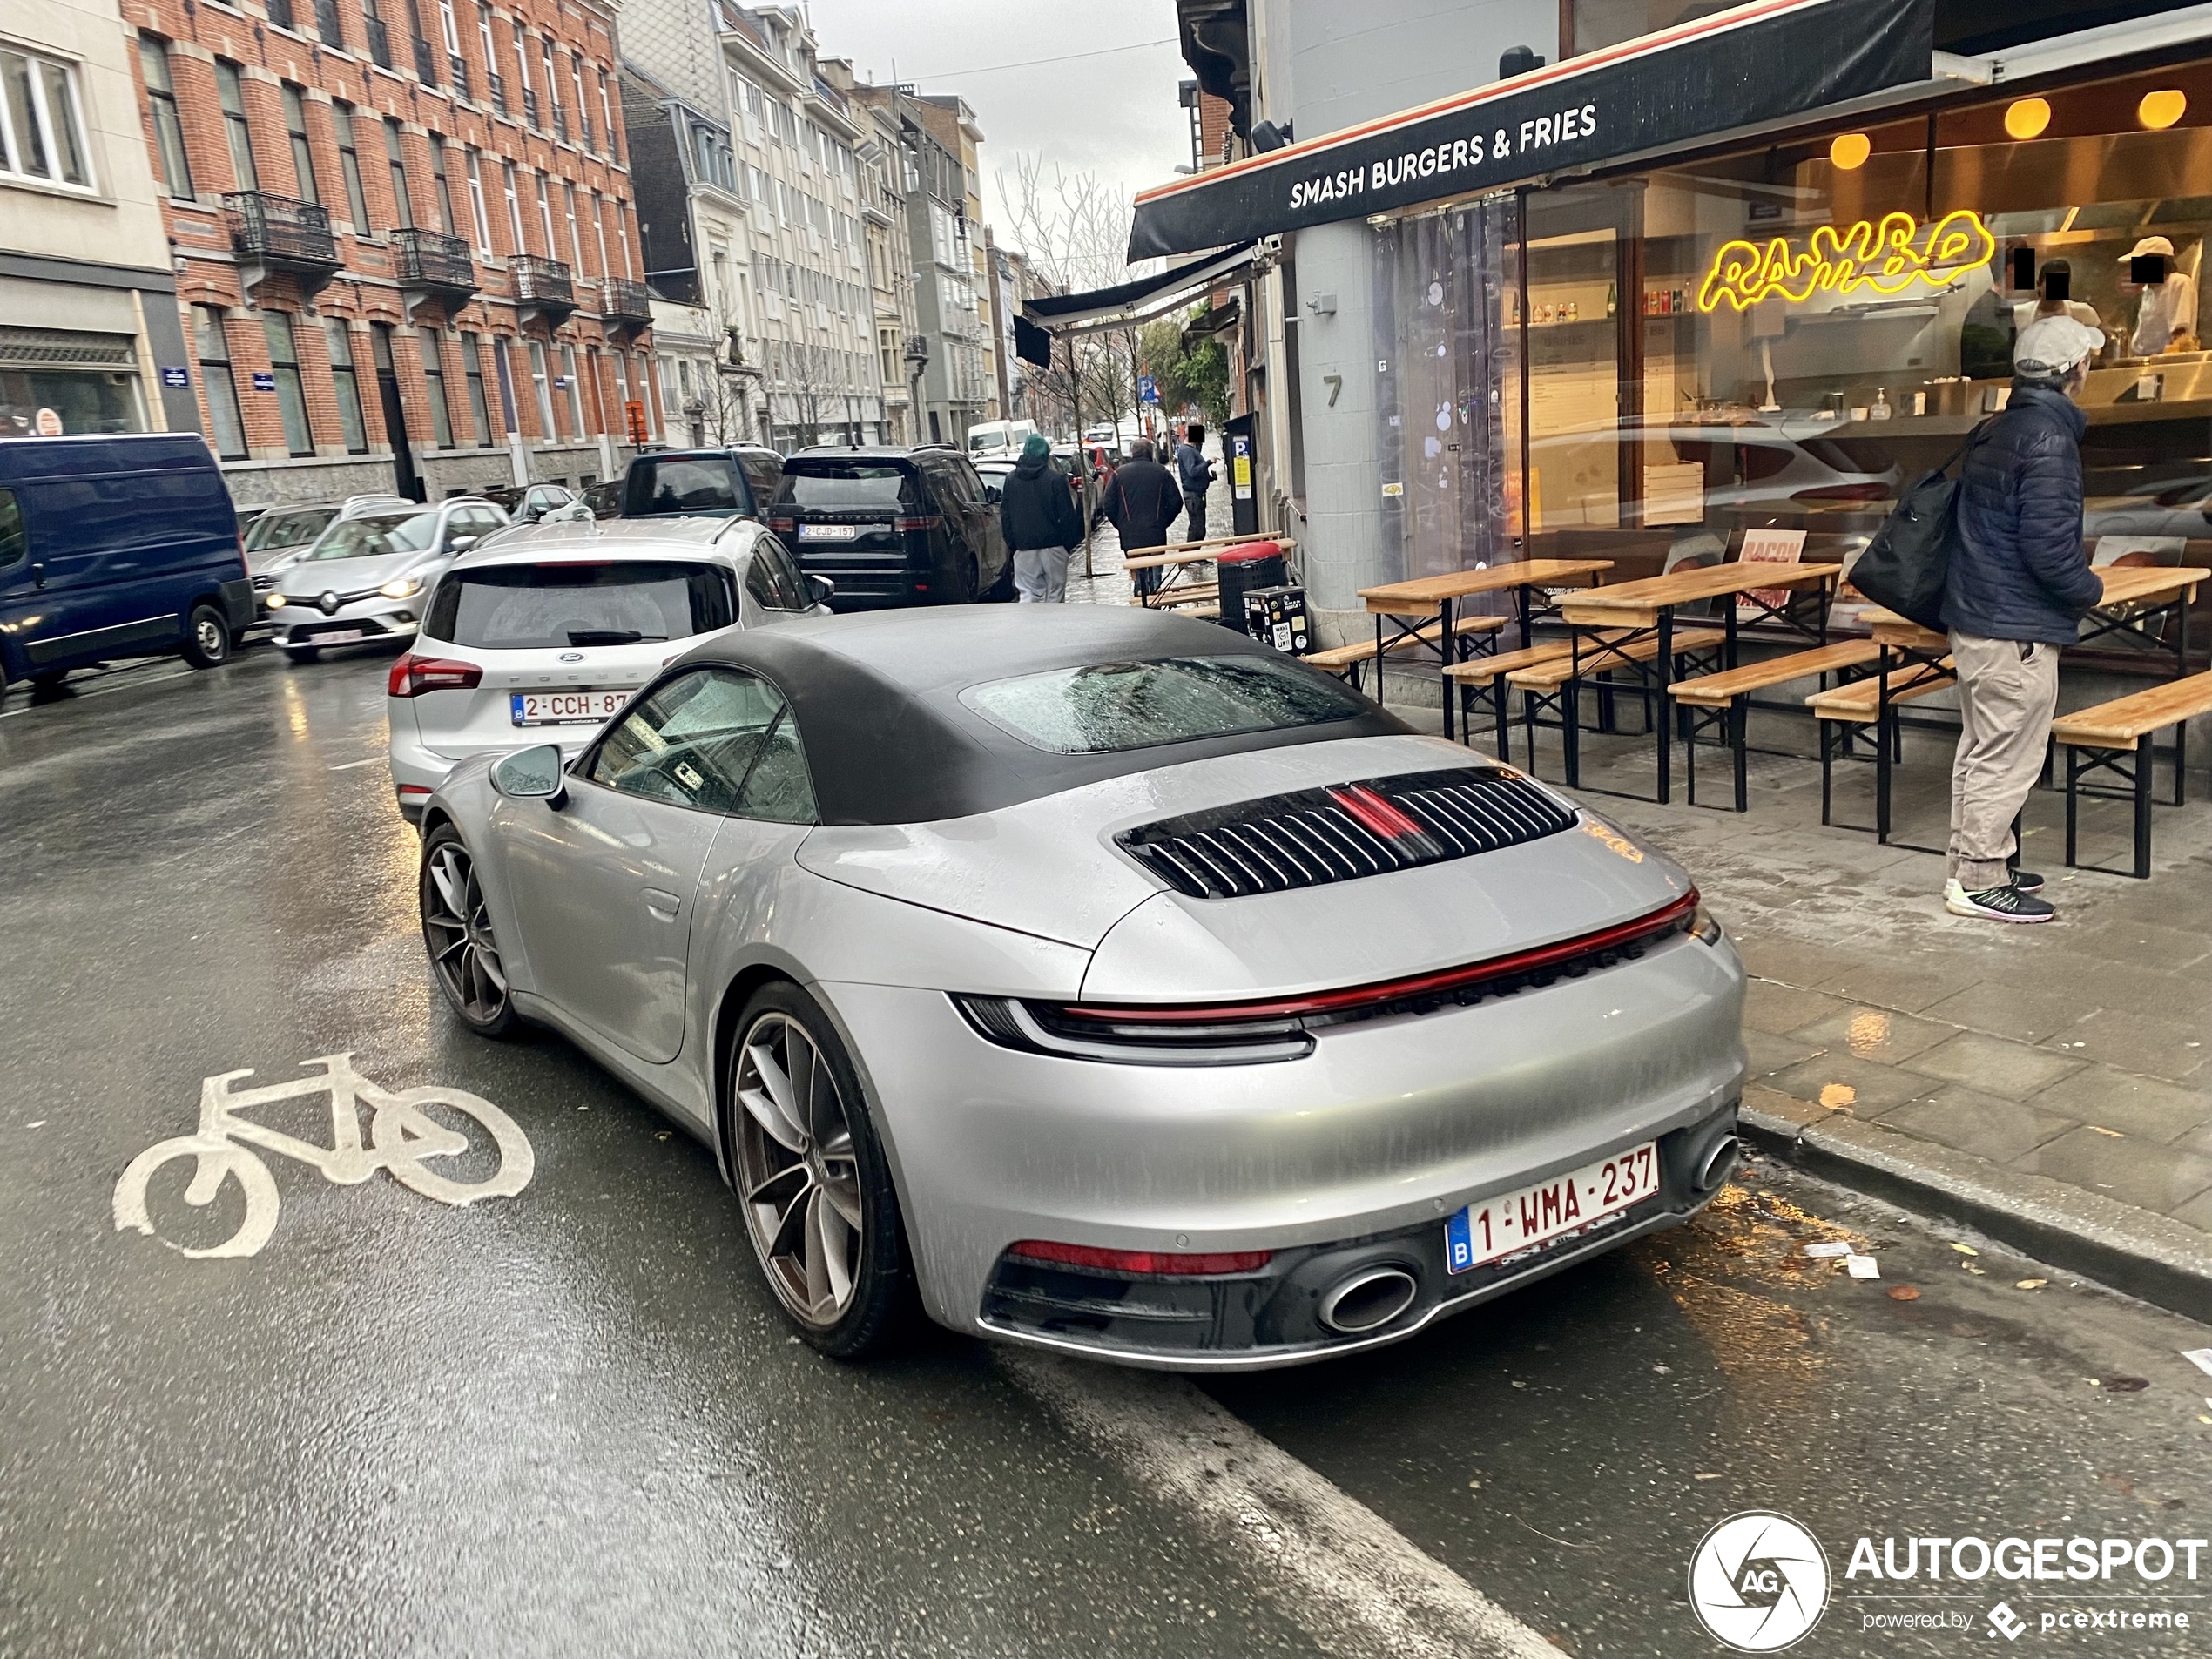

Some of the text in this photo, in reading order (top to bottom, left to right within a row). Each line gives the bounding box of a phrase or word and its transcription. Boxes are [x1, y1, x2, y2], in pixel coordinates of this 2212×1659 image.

[1289, 104, 1597, 209] SMASH BURGERS & FRIES
[1697, 209, 1996, 312] RAMBO
[1323, 374, 1342, 408] 7
[1235, 442, 1246, 456] P
[806, 527, 853, 536] 2-CJD-157
[1744, 541, 1801, 563] BACON
[509, 672, 638, 683] FOCUS
[515, 710, 523, 718] B
[526, 694, 627, 716] 2-CCH-87
[1478, 1146, 1652, 1251] 1-WMA-237
[1454, 1242, 1468, 1264] B
